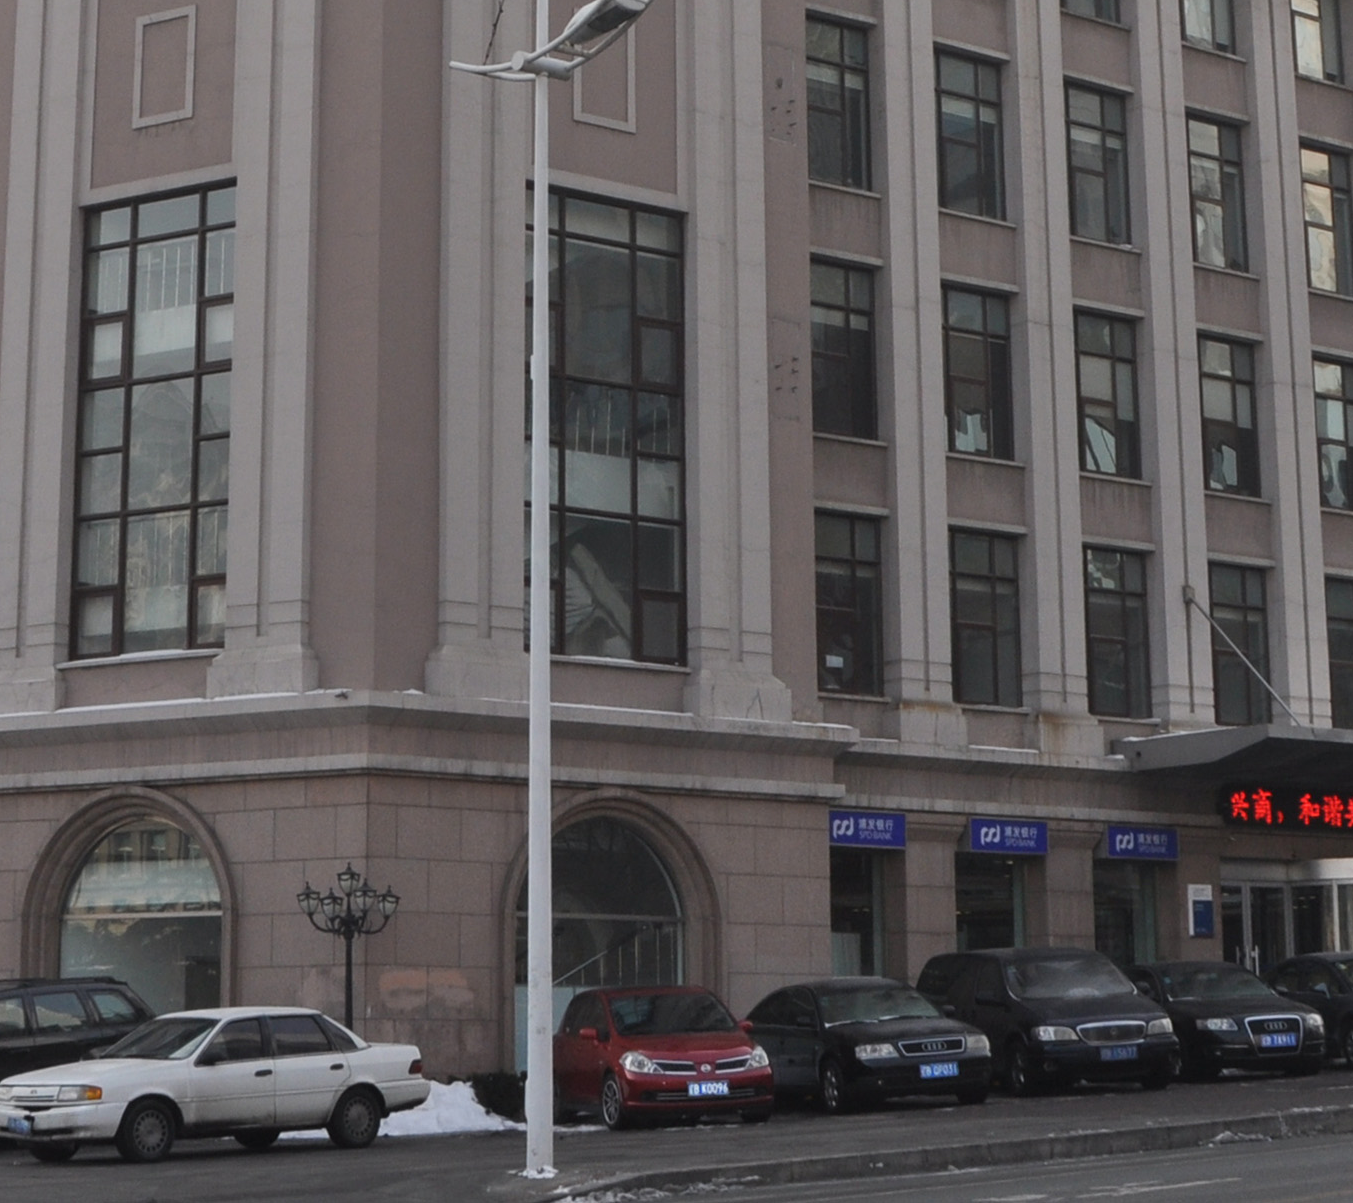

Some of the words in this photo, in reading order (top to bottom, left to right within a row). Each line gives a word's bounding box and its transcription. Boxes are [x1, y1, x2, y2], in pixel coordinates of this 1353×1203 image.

[858, 818, 894, 832] 浦发银行
[1004, 826, 1038, 839] 浦发银行
